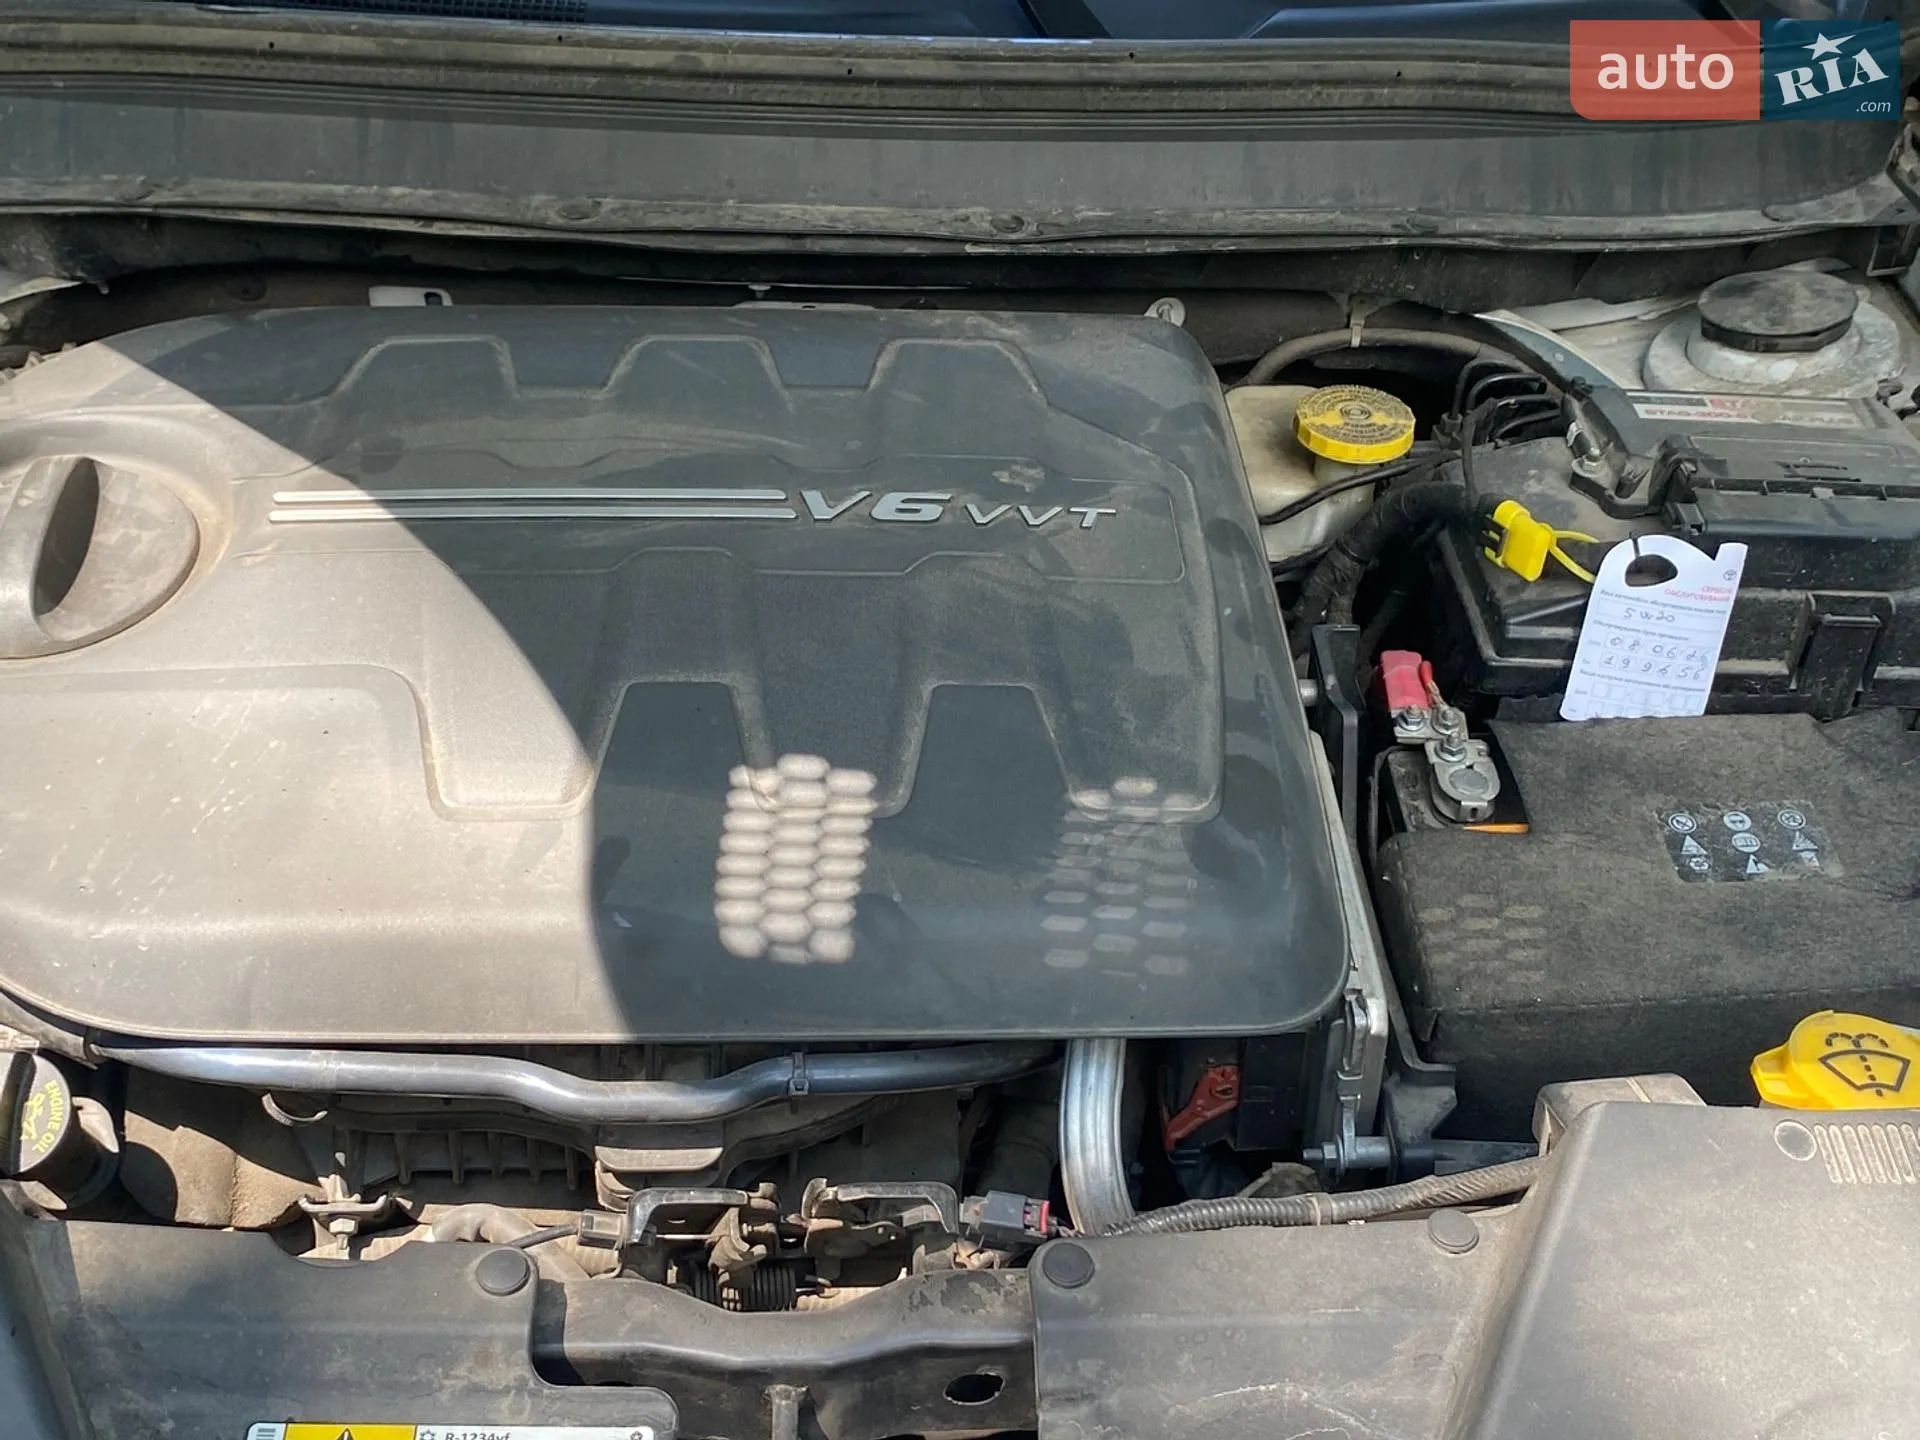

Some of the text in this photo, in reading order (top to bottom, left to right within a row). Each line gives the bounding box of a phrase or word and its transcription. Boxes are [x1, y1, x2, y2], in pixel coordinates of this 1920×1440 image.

[801, 490, 1117, 528] V6 VVT
[32, 1080, 63, 1153] ENGINE OIL
